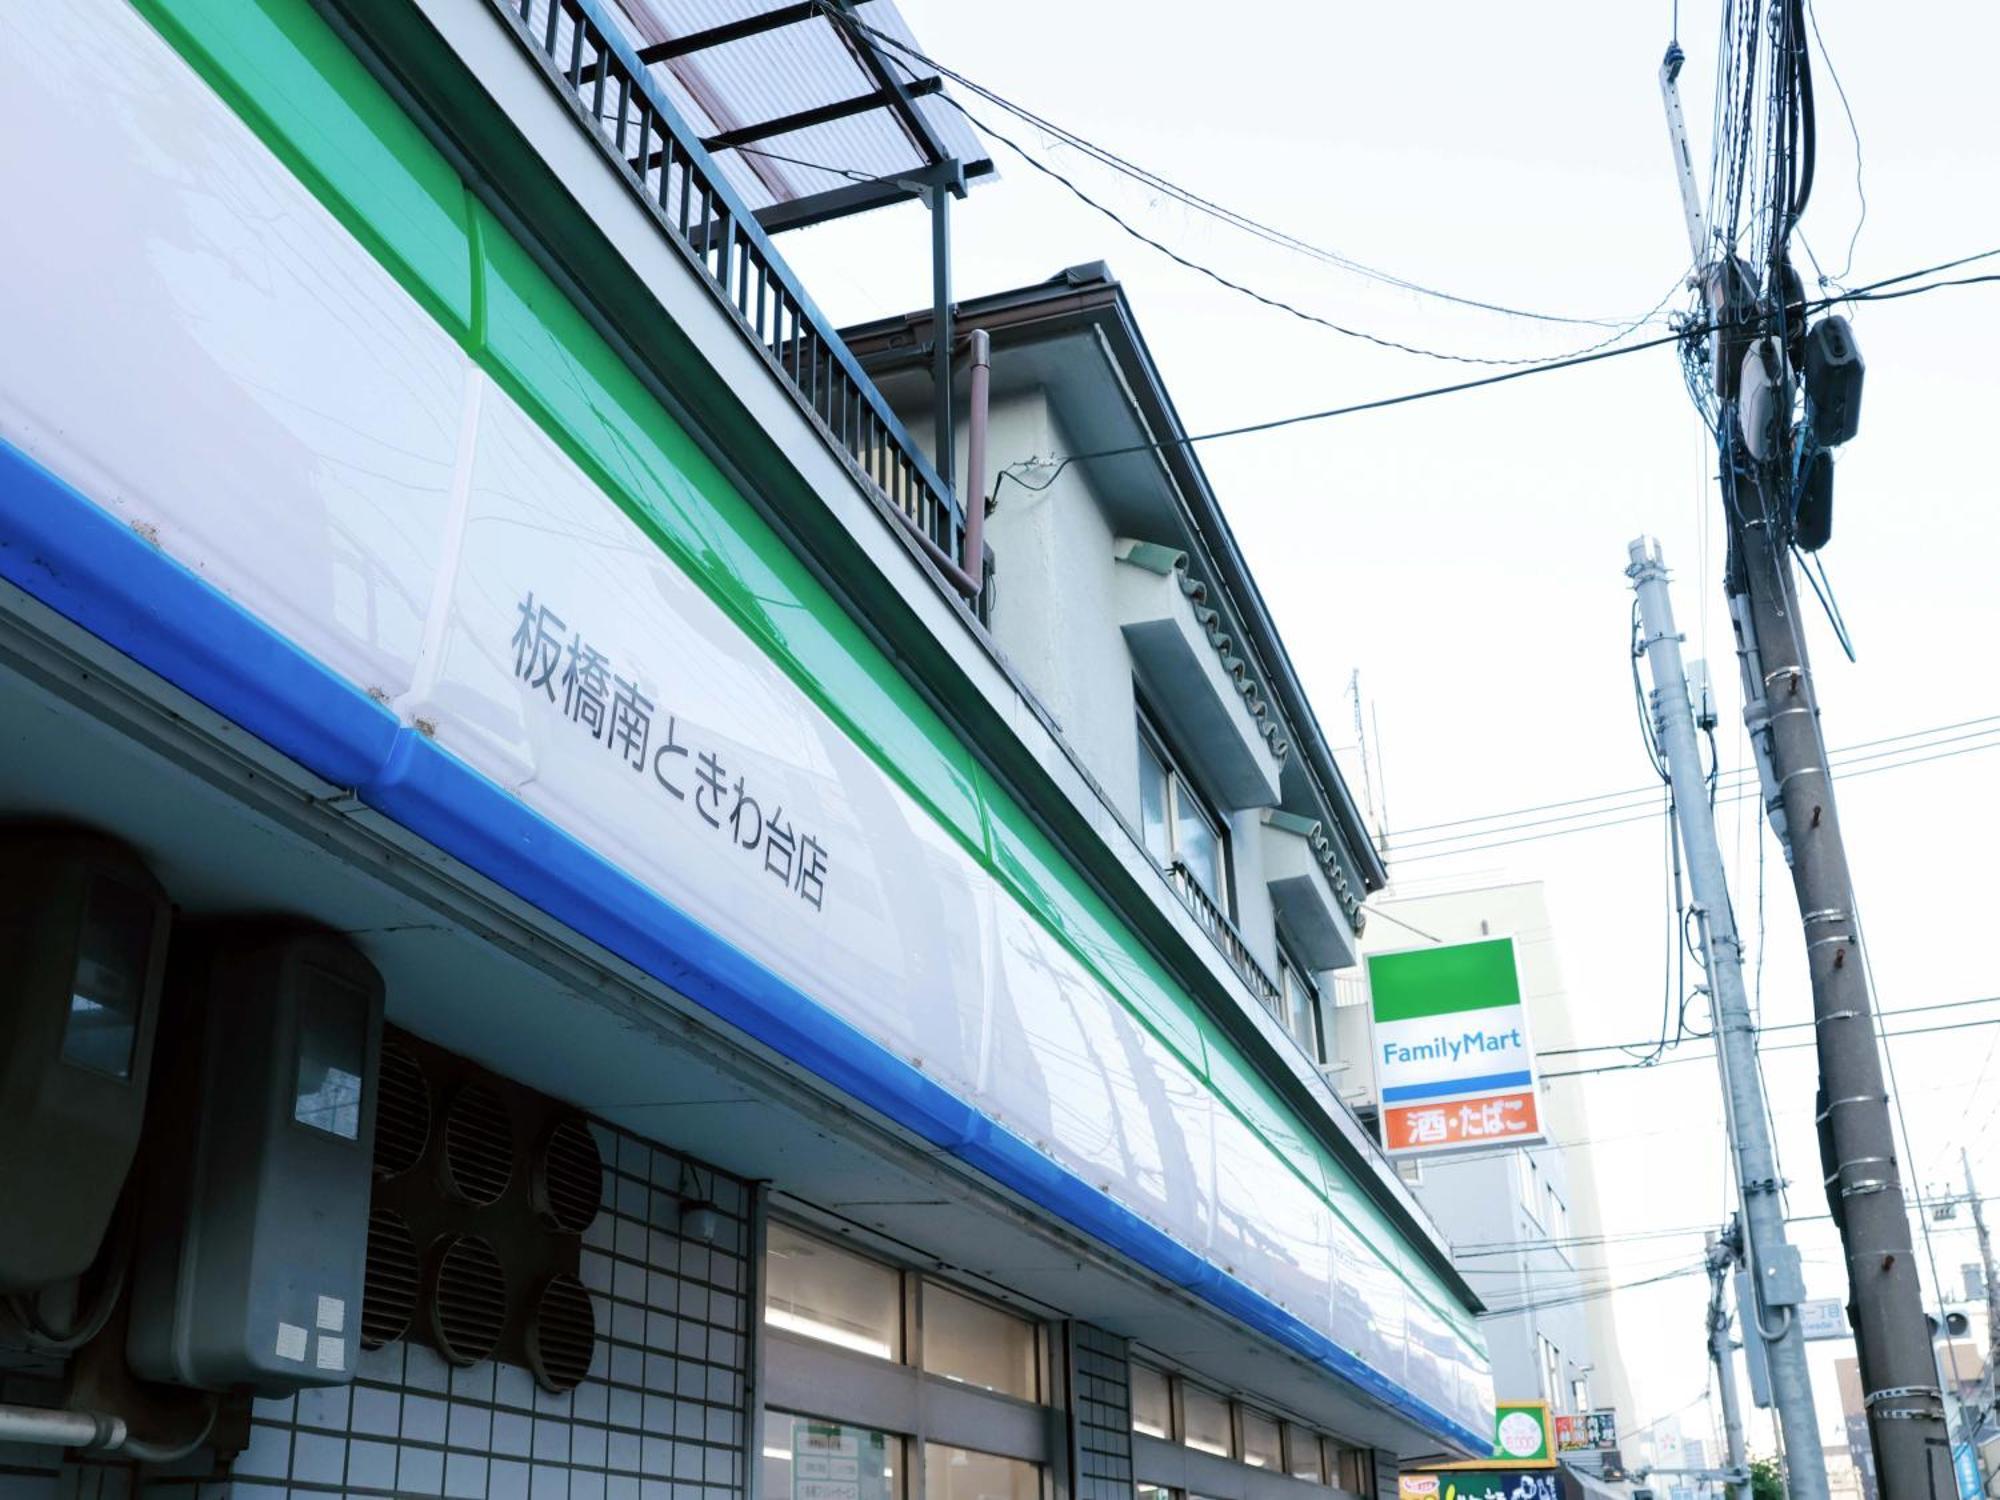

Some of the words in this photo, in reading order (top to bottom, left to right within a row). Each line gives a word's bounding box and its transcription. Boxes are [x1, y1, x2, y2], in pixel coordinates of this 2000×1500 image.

[511, 591, 828, 912] 板橋南ときわ台店
[1384, 1028, 1522, 1065] FamilyMart
